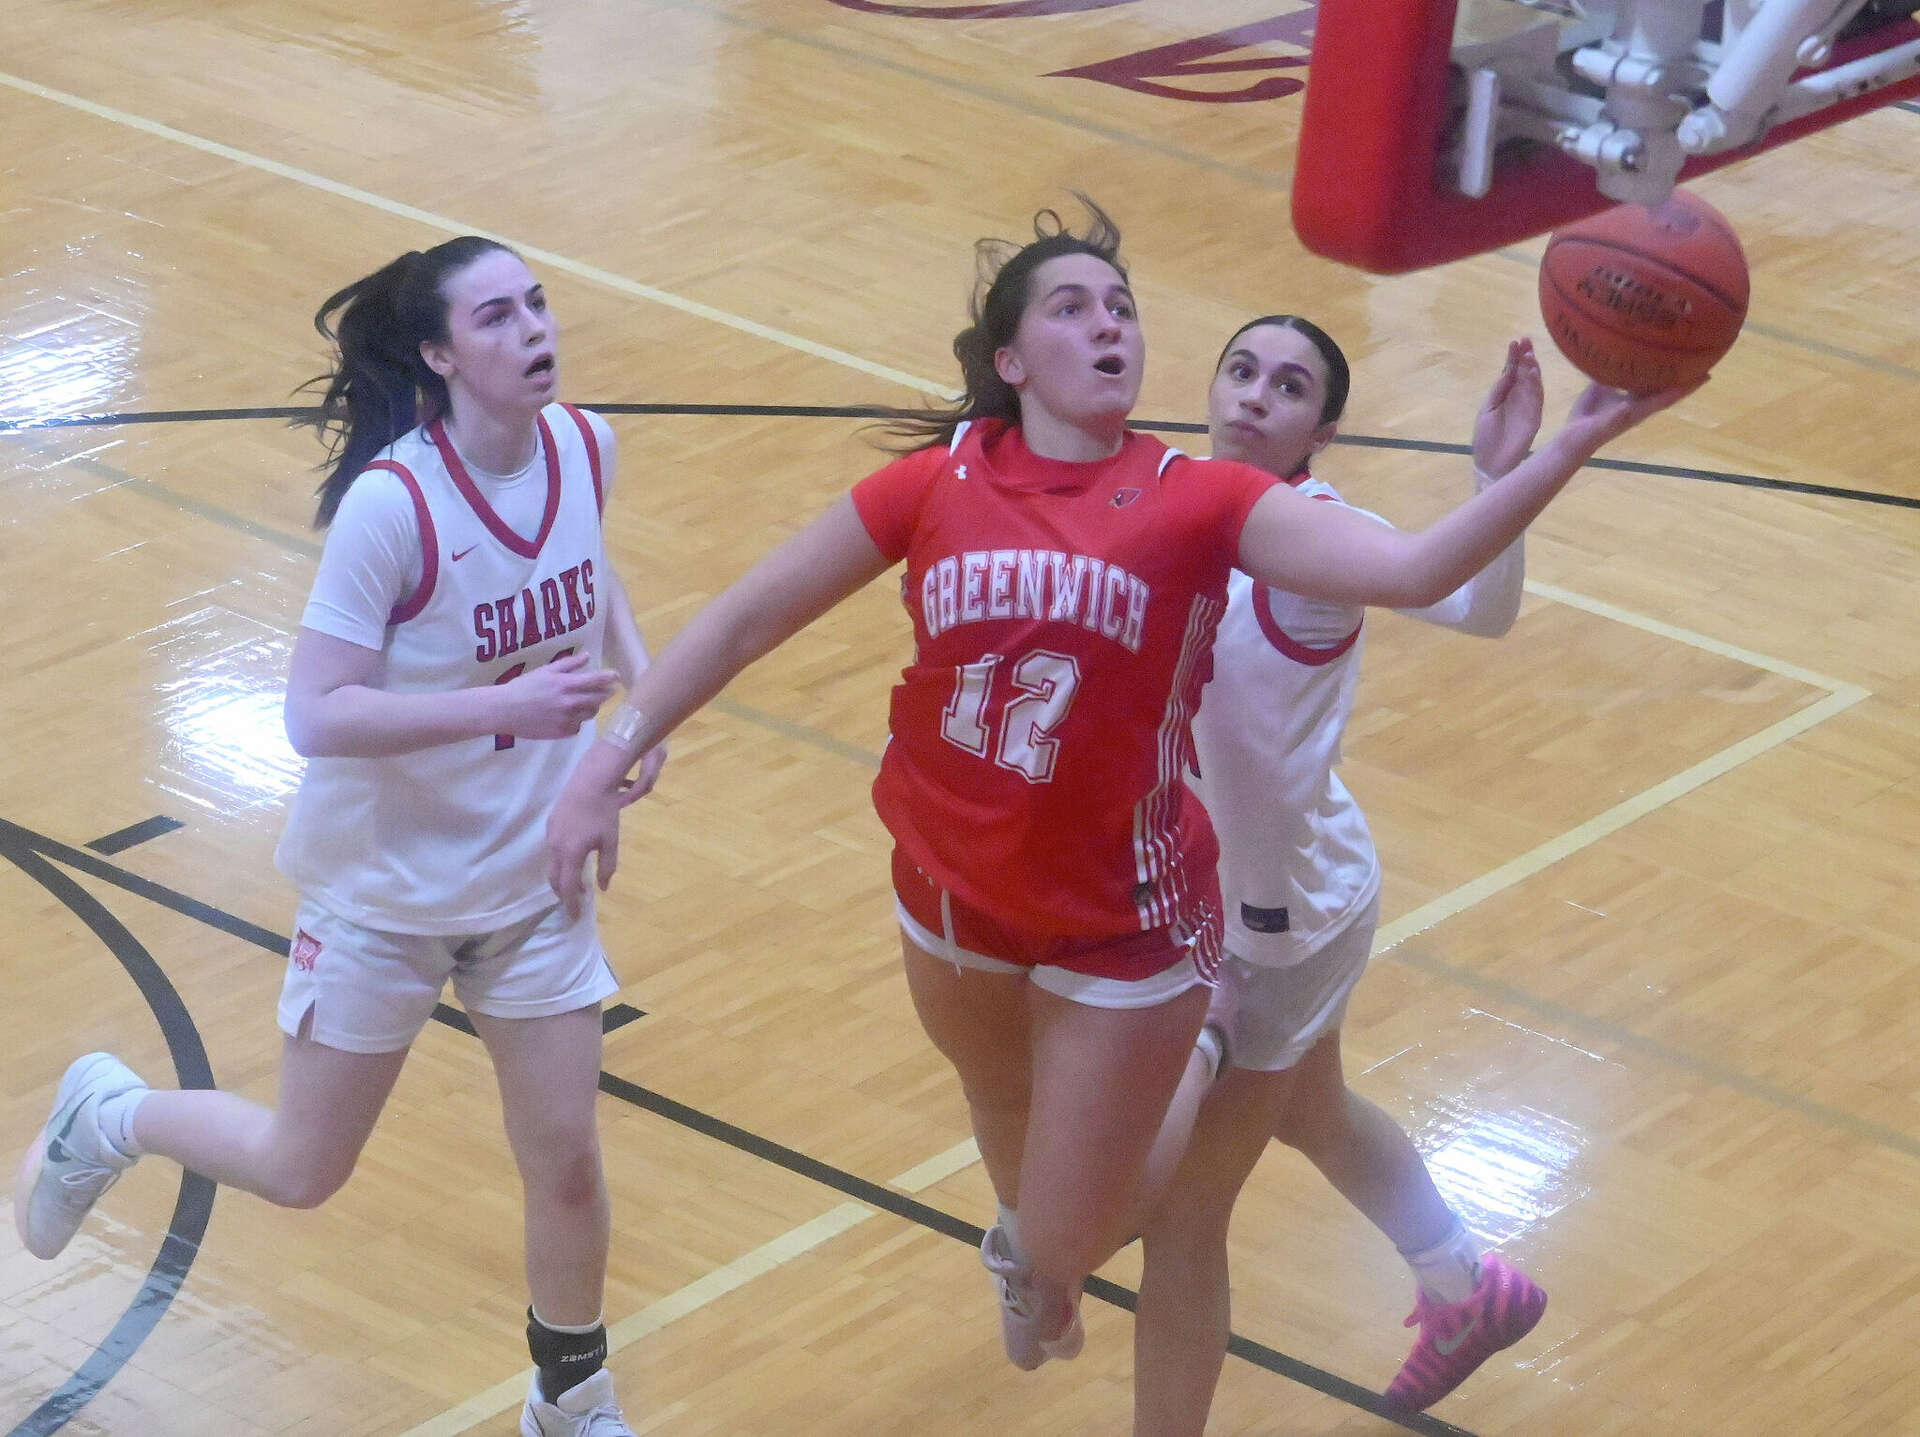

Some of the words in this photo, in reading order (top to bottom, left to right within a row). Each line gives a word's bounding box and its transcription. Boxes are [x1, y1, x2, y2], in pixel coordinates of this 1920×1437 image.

[474, 558, 596, 662] SHARKS
[922, 549, 1150, 653] GREENWICH
[940, 648, 1082, 785] 12
